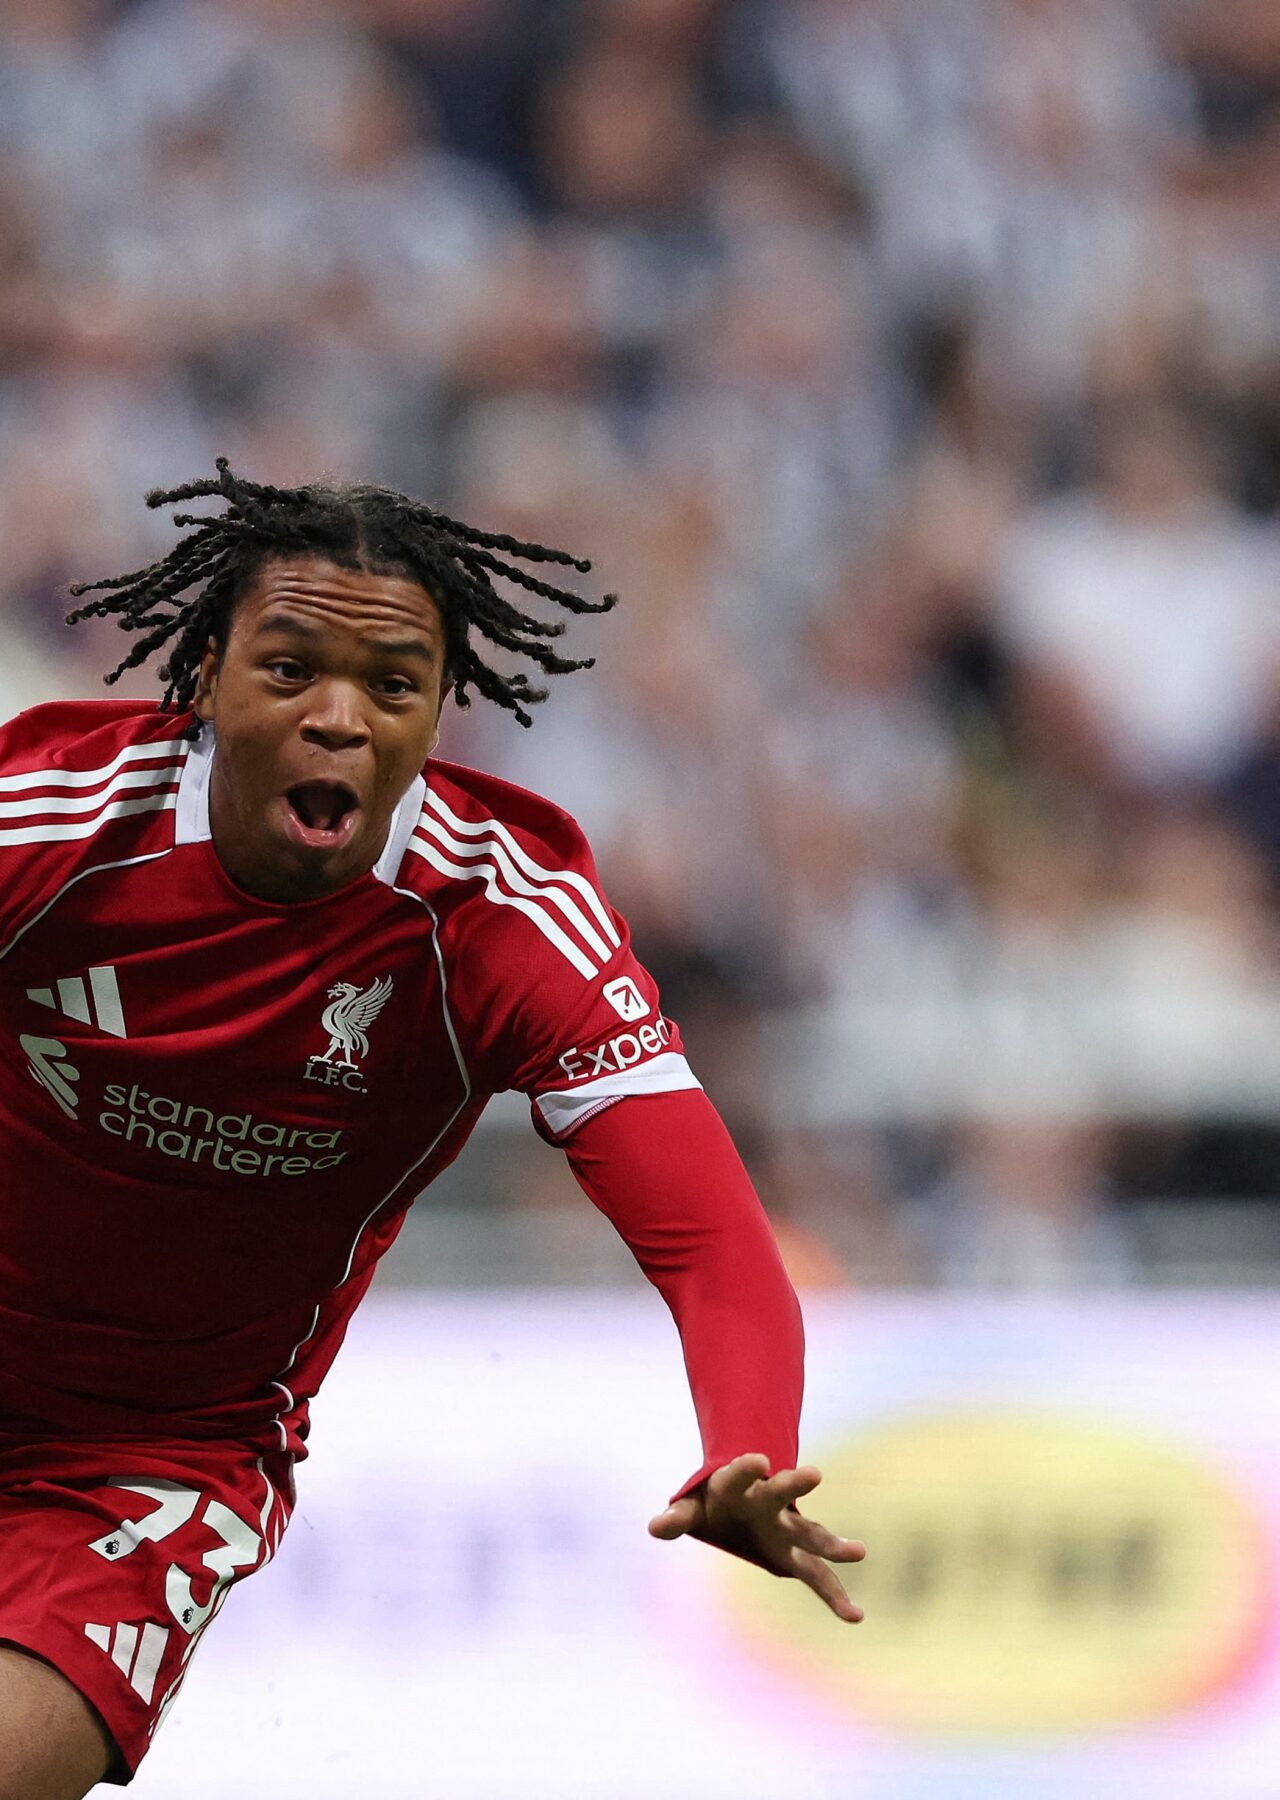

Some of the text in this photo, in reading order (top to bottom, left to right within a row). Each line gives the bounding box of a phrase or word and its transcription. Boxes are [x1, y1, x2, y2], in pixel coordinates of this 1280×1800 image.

[99, 1112, 347, 1176] chartered
[103, 1083, 343, 1150] standard
[87, 1475, 264, 1635] 73
